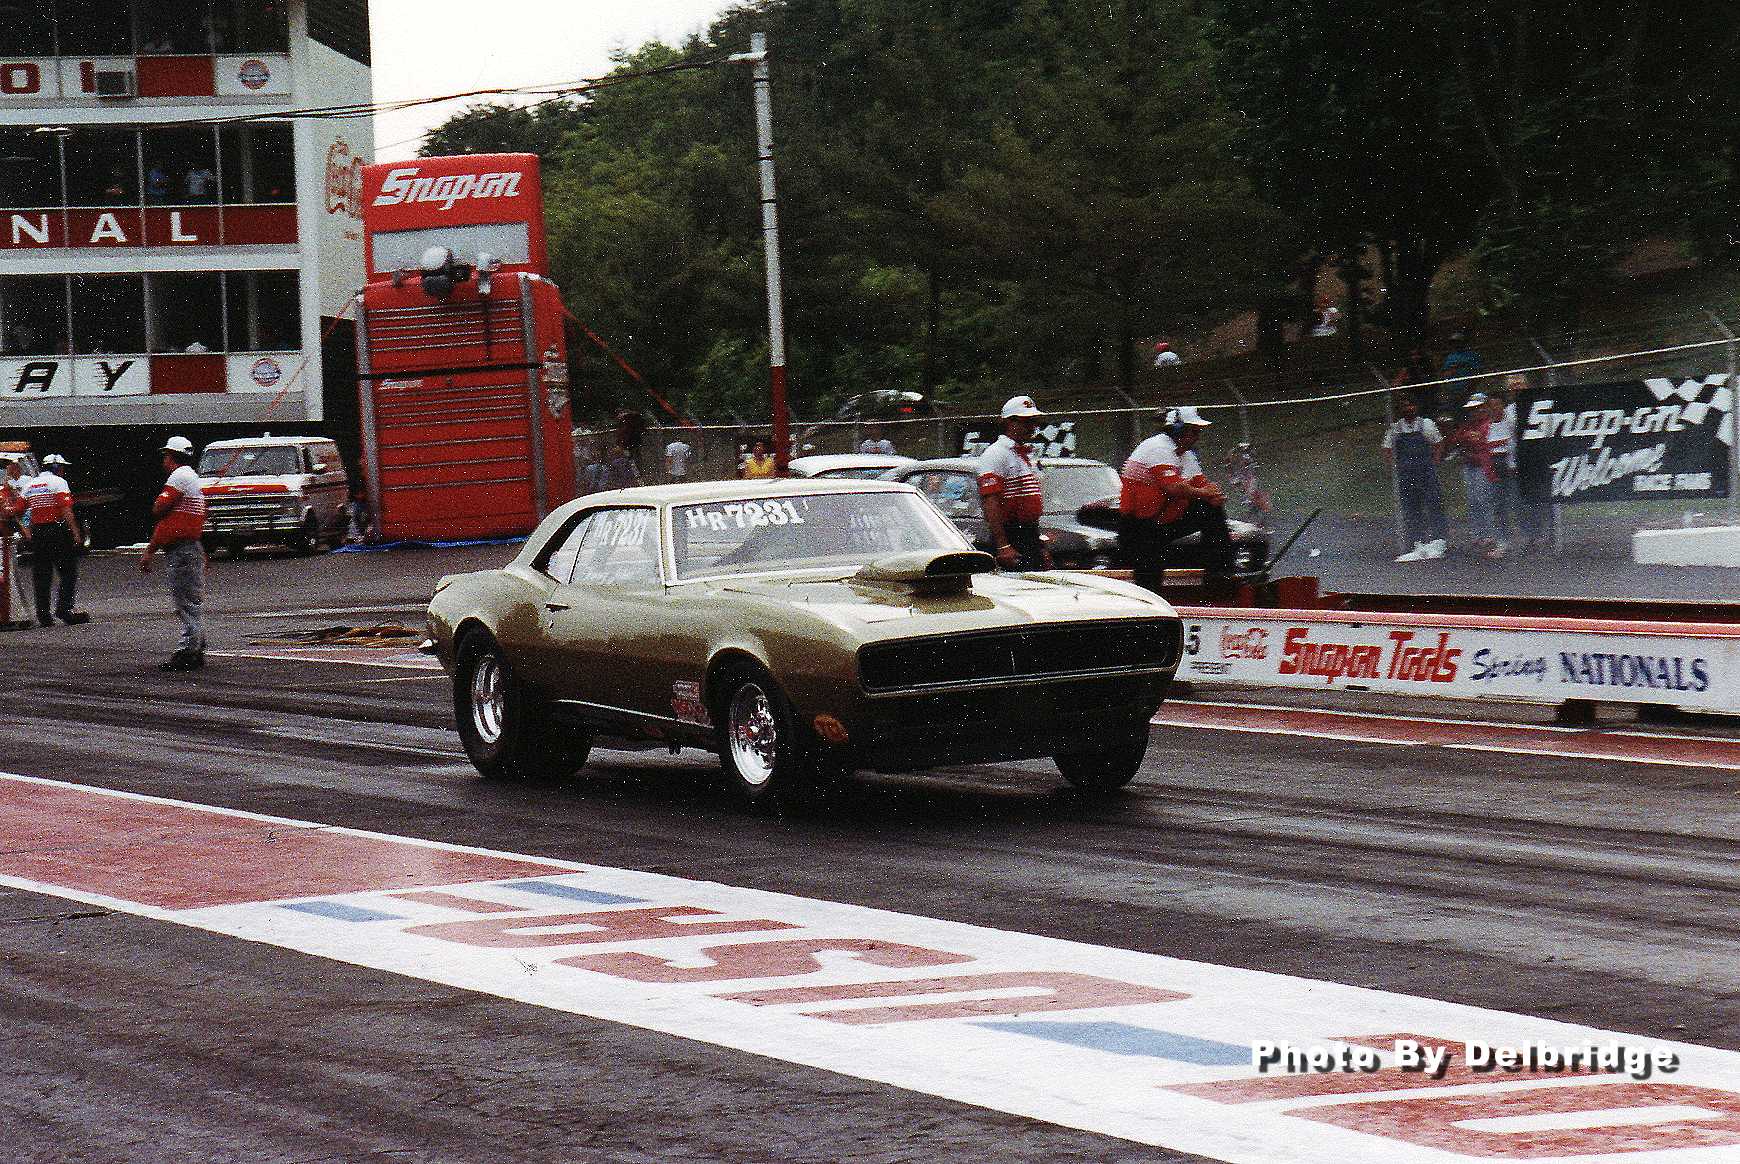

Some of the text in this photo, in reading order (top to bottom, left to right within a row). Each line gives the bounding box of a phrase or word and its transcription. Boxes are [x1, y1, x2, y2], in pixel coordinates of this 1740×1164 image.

[371, 167, 522, 211] Snap-on
[1522, 399, 1686, 450] Snap-on
[1386, 630, 1463, 683] Tools
[1558, 651, 1711, 693] NATIONALS
